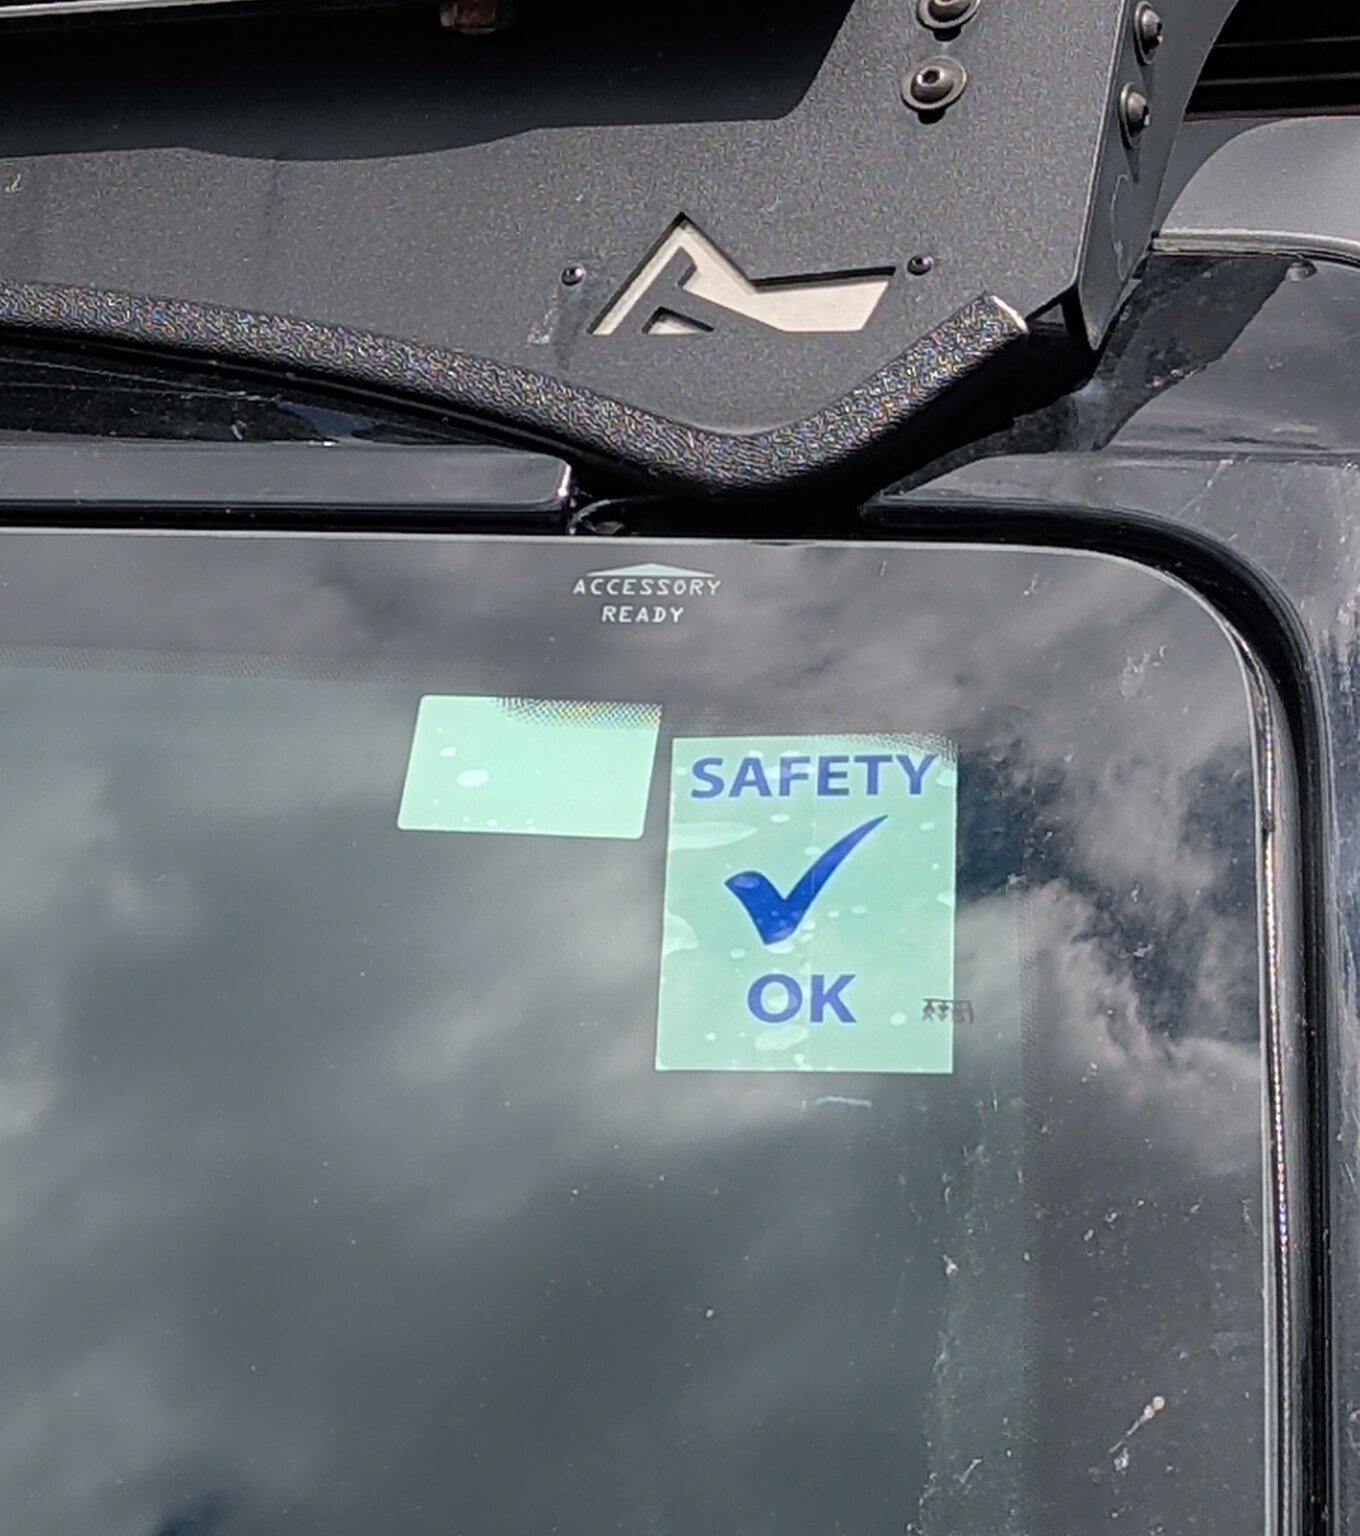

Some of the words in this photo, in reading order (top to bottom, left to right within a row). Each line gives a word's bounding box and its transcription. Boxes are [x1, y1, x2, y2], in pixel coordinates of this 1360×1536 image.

[572, 578, 721, 596] ACCESSORY
[601, 605, 684, 623] READY
[689, 753, 938, 799] SAFETY
[746, 973, 858, 1024] OK
